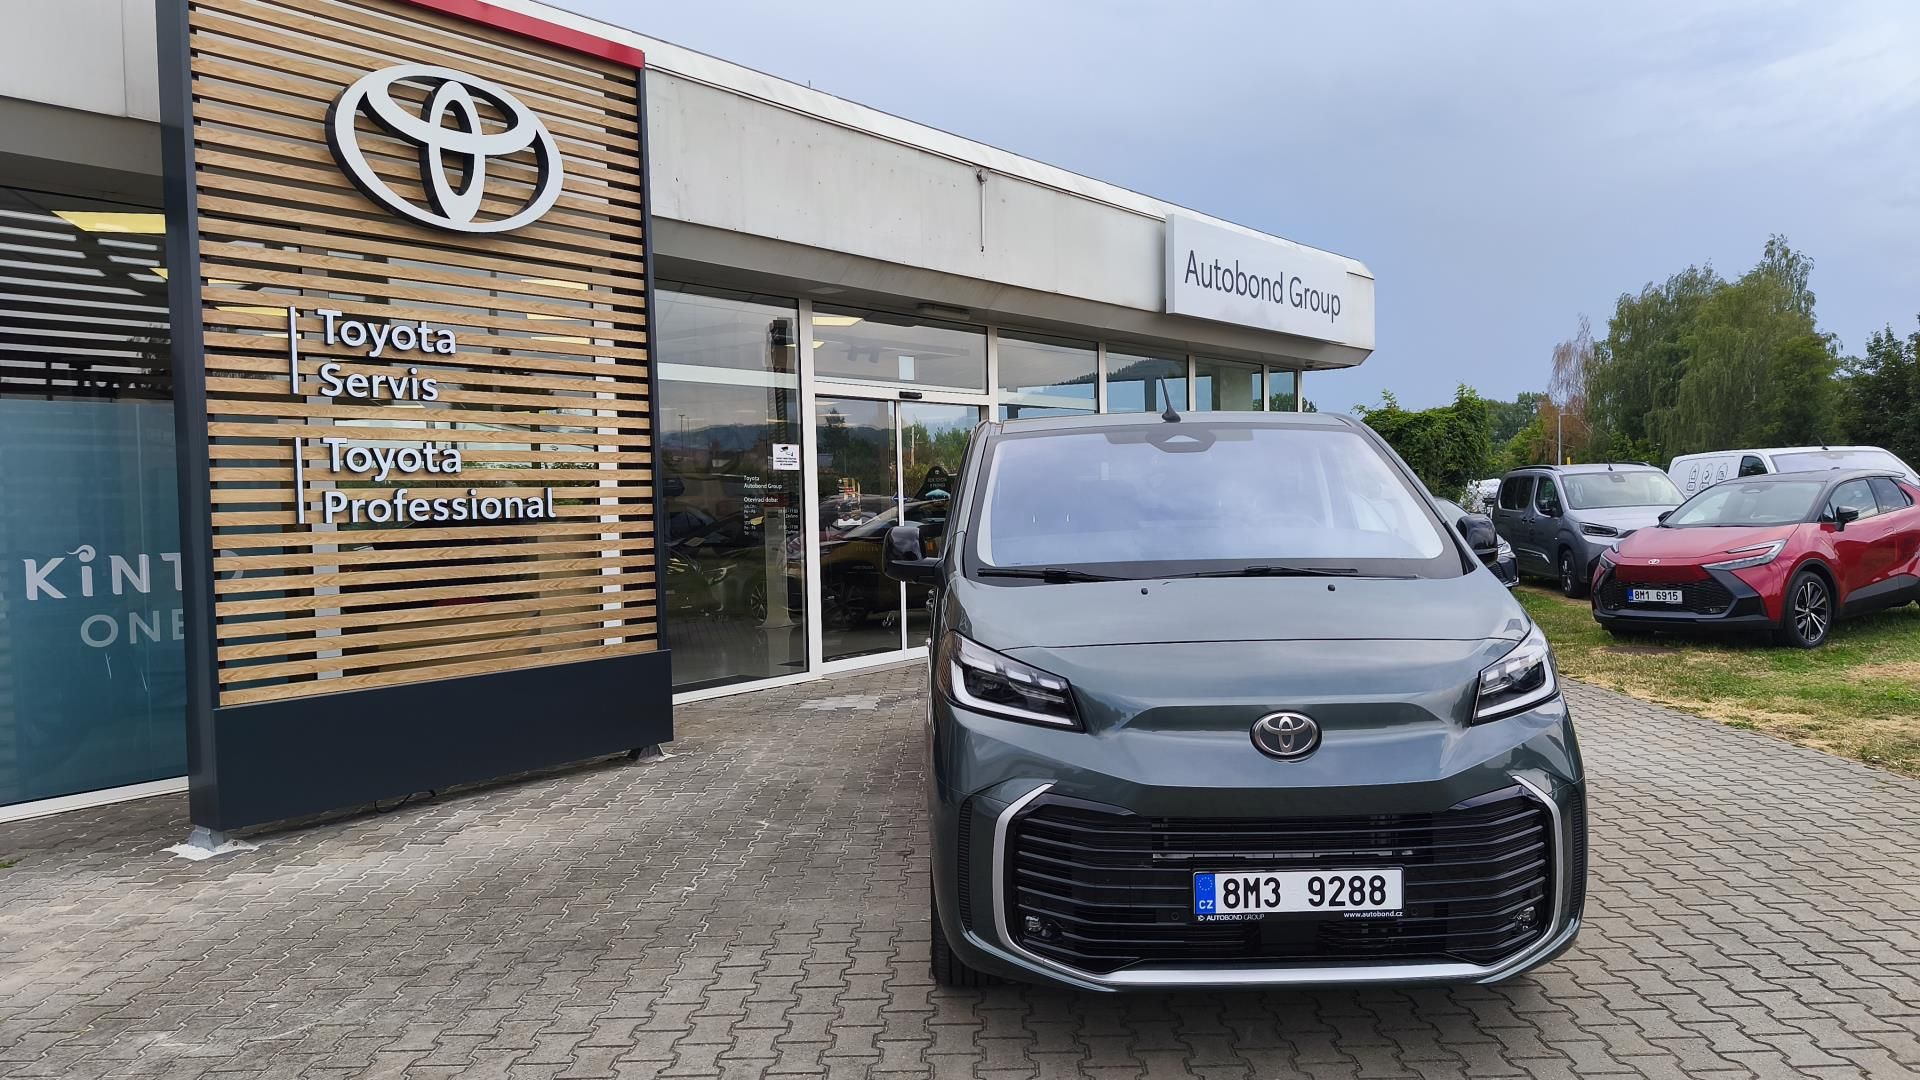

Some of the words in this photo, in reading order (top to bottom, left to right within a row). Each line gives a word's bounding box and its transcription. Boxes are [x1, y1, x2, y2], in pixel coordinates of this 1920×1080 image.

[1185, 250, 1283, 304] Autobond
[1290, 276, 1341, 323] Group
[316, 309, 456, 357] Toyota
[319, 363, 439, 400] Servis
[321, 437, 462, 482] Toyota
[323, 487, 556, 524] Professional
[1634, 590, 1650, 600] 8M1
[1656, 591, 1678, 601] 6915
[1198, 900, 1214, 910] CZ
[1223, 877, 1281, 909] 8M3
[1308, 875, 1386, 907] 9288
[1243, 913, 1265, 921] GROUP
[1343, 910, 1403, 918] www.autobond.cz
